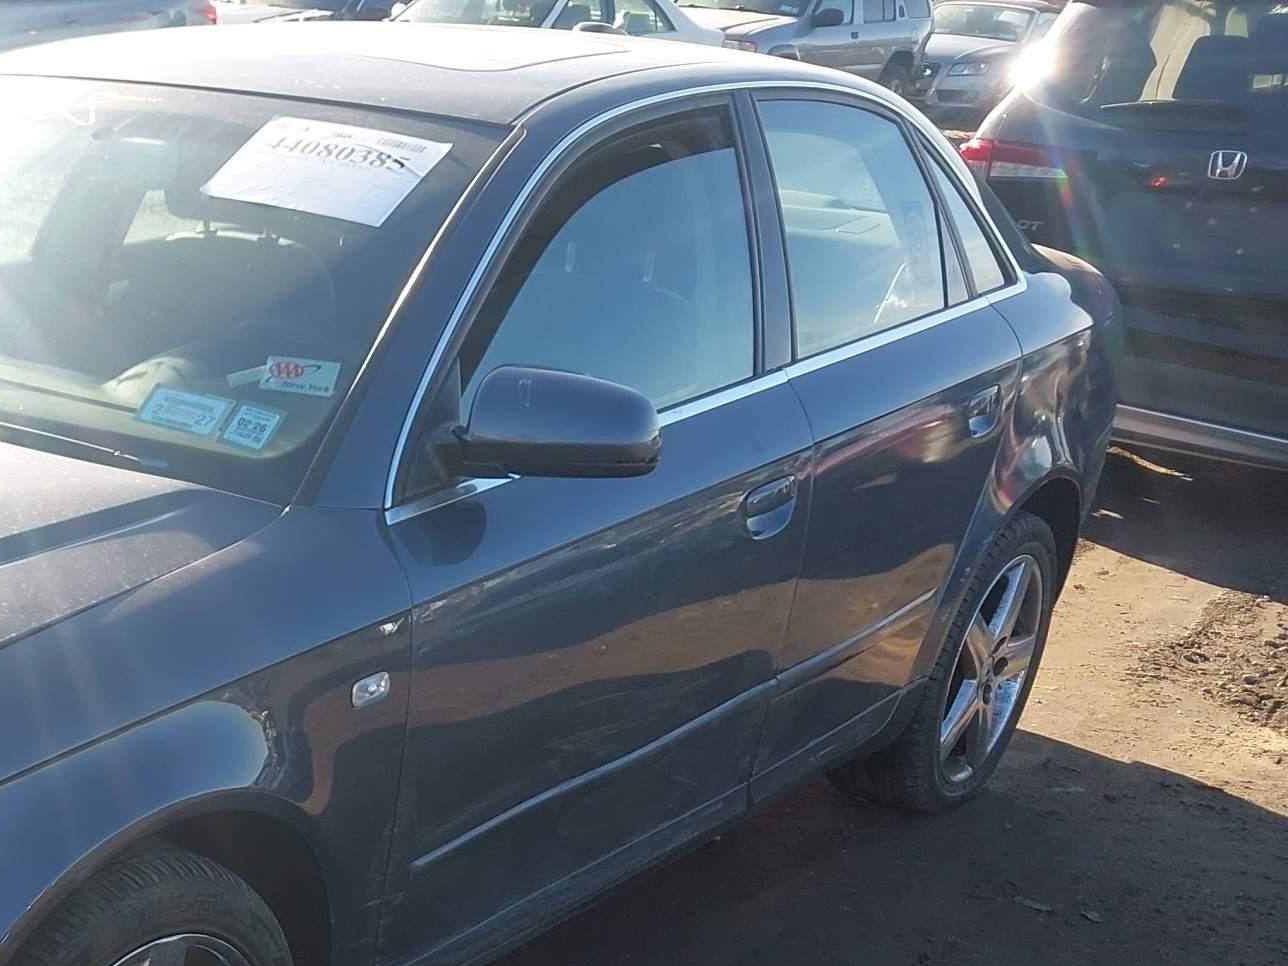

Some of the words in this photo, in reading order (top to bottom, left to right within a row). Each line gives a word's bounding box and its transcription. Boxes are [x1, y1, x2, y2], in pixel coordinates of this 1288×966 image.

[267, 136, 411, 171] 44080385
[272, 362, 303, 379] AAA
[281, 380, 306, 390] New
[309, 384, 330, 393] York
